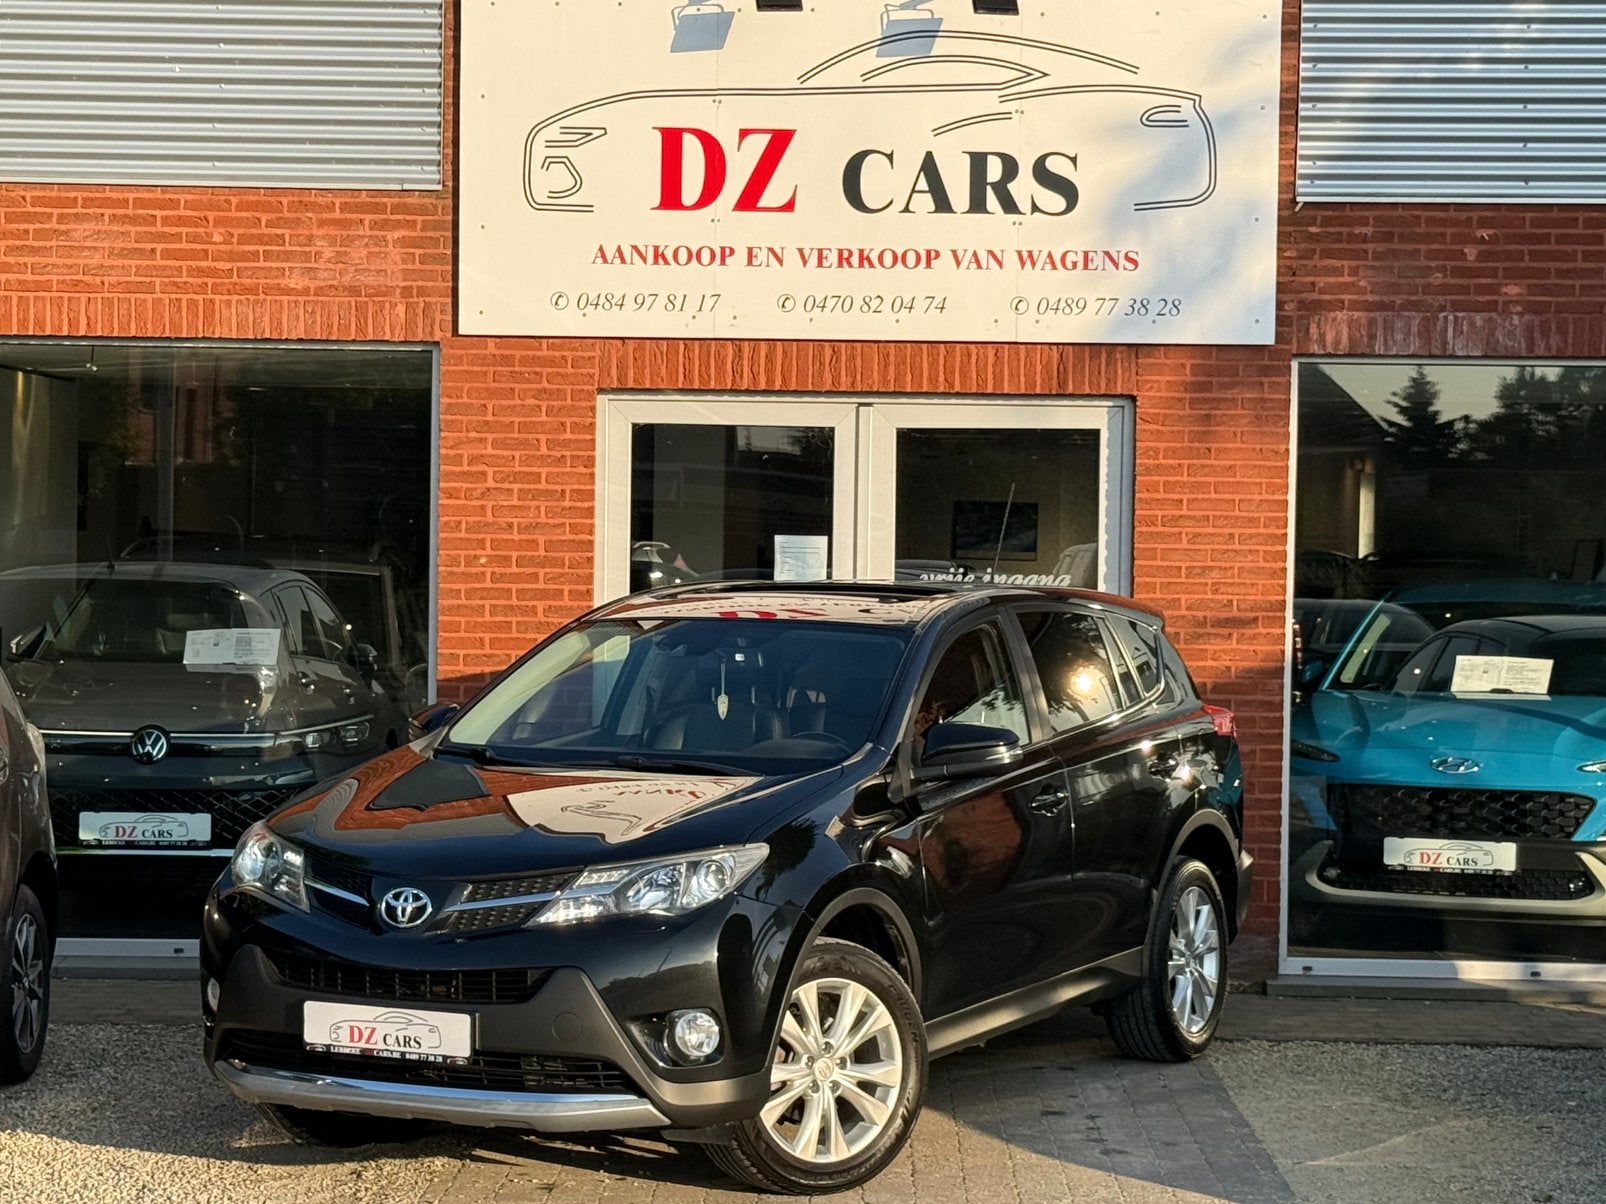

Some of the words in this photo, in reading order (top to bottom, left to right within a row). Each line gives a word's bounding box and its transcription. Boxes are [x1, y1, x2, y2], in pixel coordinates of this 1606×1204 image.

[650, 126, 797, 213] DZ
[841, 149, 1080, 216] CARS
[591, 244, 735, 267] AANKOOP
[744, 246, 785, 268] EN
[795, 248, 941, 270] VERKOOP
[950, 249, 1004, 270] VAN
[1014, 250, 1140, 272] WAGENS
[576, 292, 627, 312] 0484
[632, 293, 659, 312] 97
[664, 294, 688, 313] 81
[697, 294, 721, 313] 17
[803, 294, 854, 314] 0470
[859, 294, 883, 314] 82
[890, 295, 916, 314] 04
[922, 296, 947, 314] 74
[1036, 296, 1087, 316] 0489
[1093, 298, 1119, 316] 77
[1124, 298, 1150, 317] 38
[1155, 298, 1182, 317] 28
[114, 825, 138, 839] DZ
[141, 829, 173, 839] CARS
[1419, 851, 1442, 865] DZ
[1446, 857, 1478, 867] CARS
[348, 1024, 378, 1045] DZ
[382, 1033, 422, 1049] CARS
